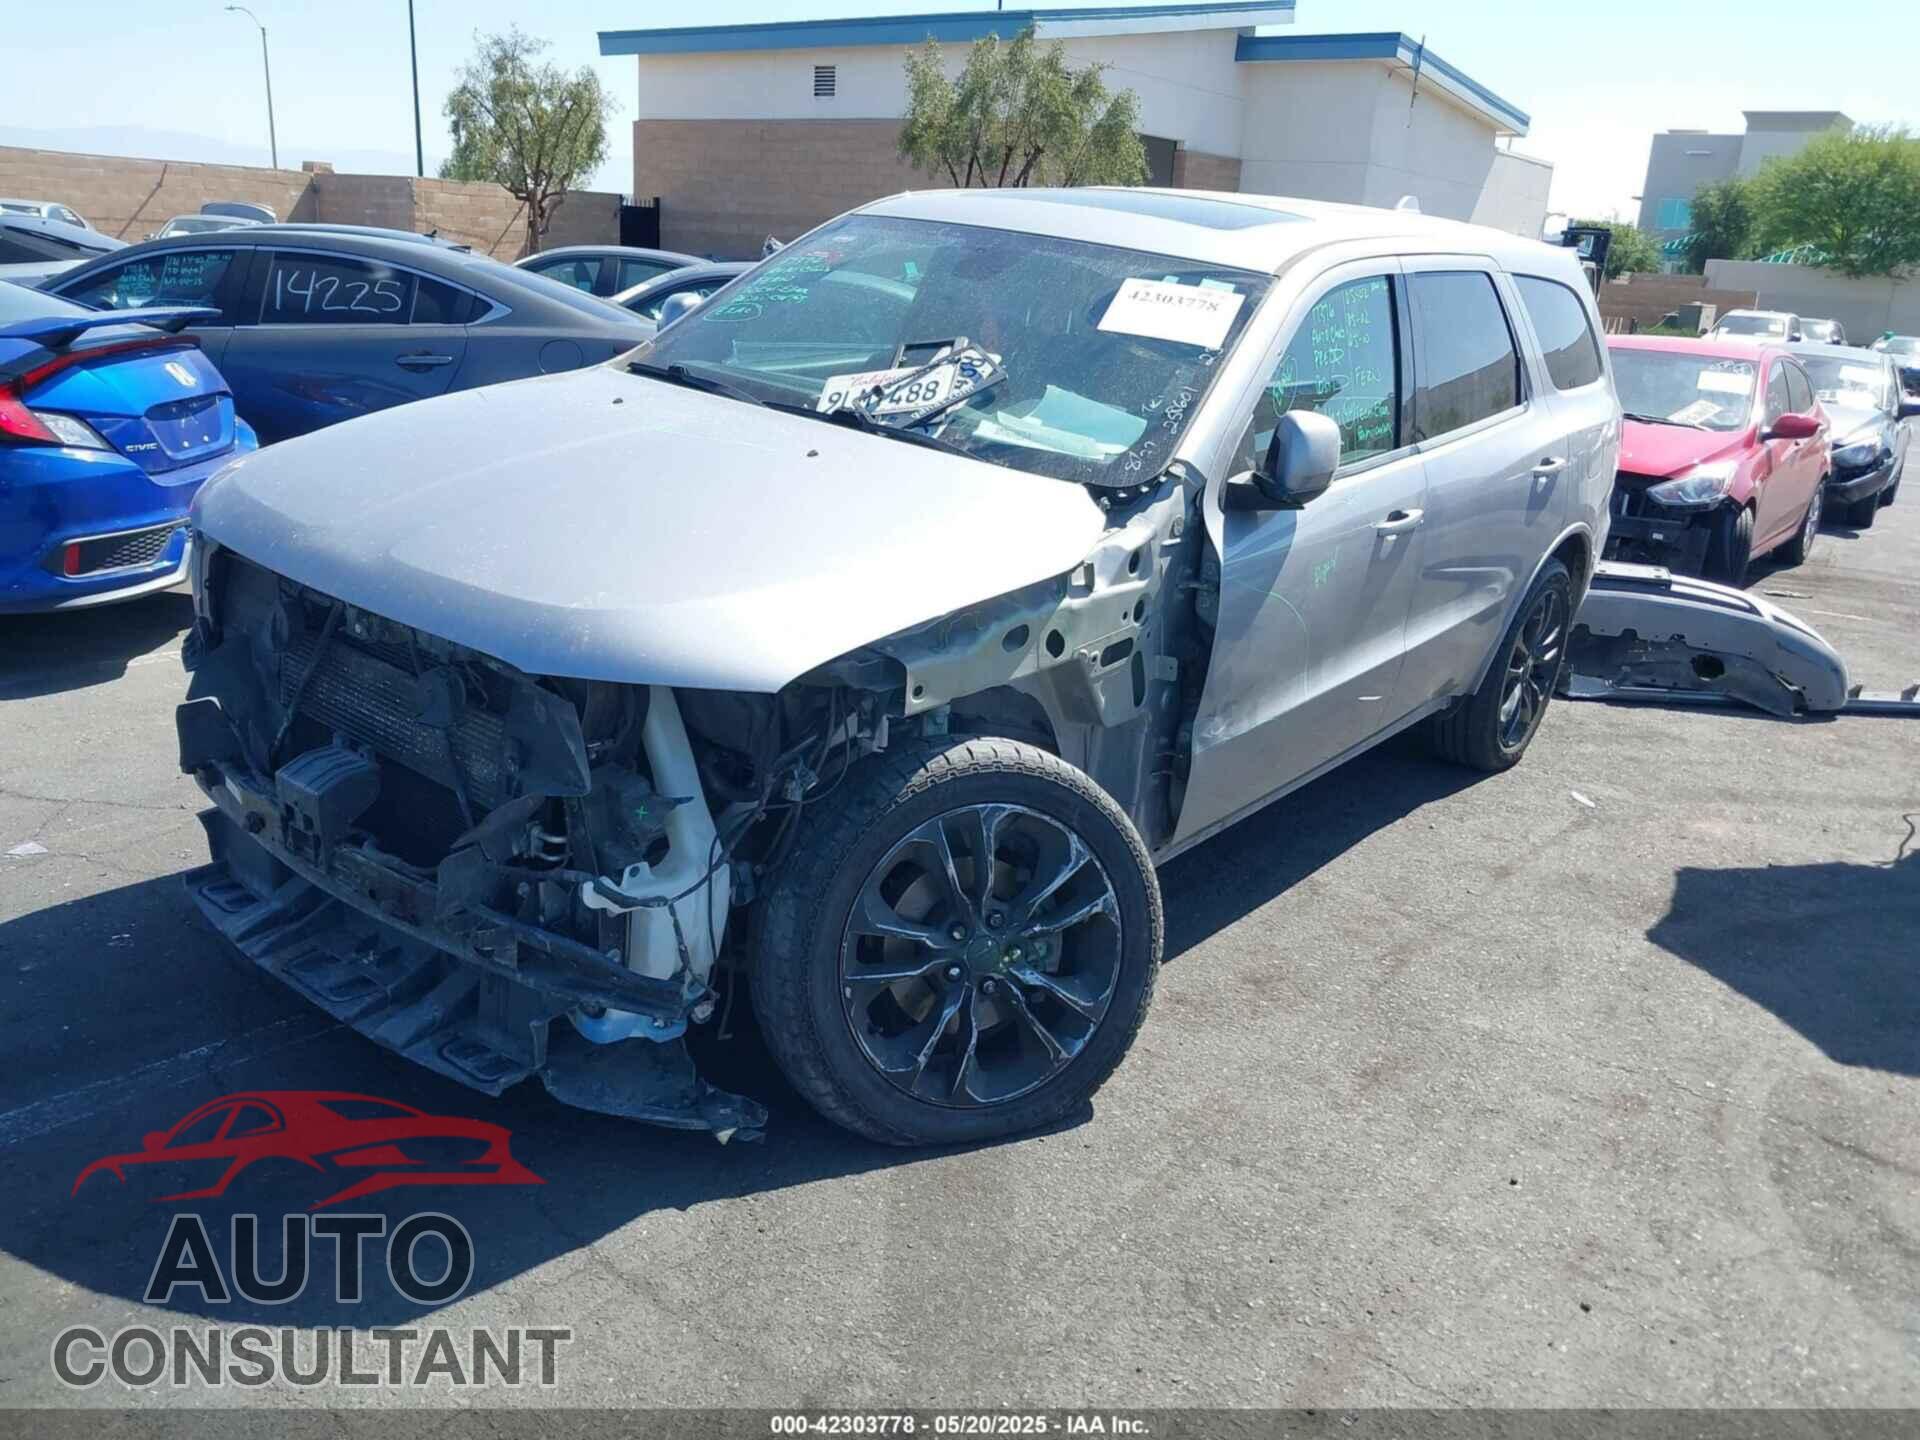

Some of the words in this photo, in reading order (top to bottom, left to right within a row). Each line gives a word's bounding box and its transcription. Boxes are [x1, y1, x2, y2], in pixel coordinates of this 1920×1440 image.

[275, 269, 401, 313] 14225
[1128, 290, 1220, 312] 42303778
[125, 442, 159, 453] CIVIC
